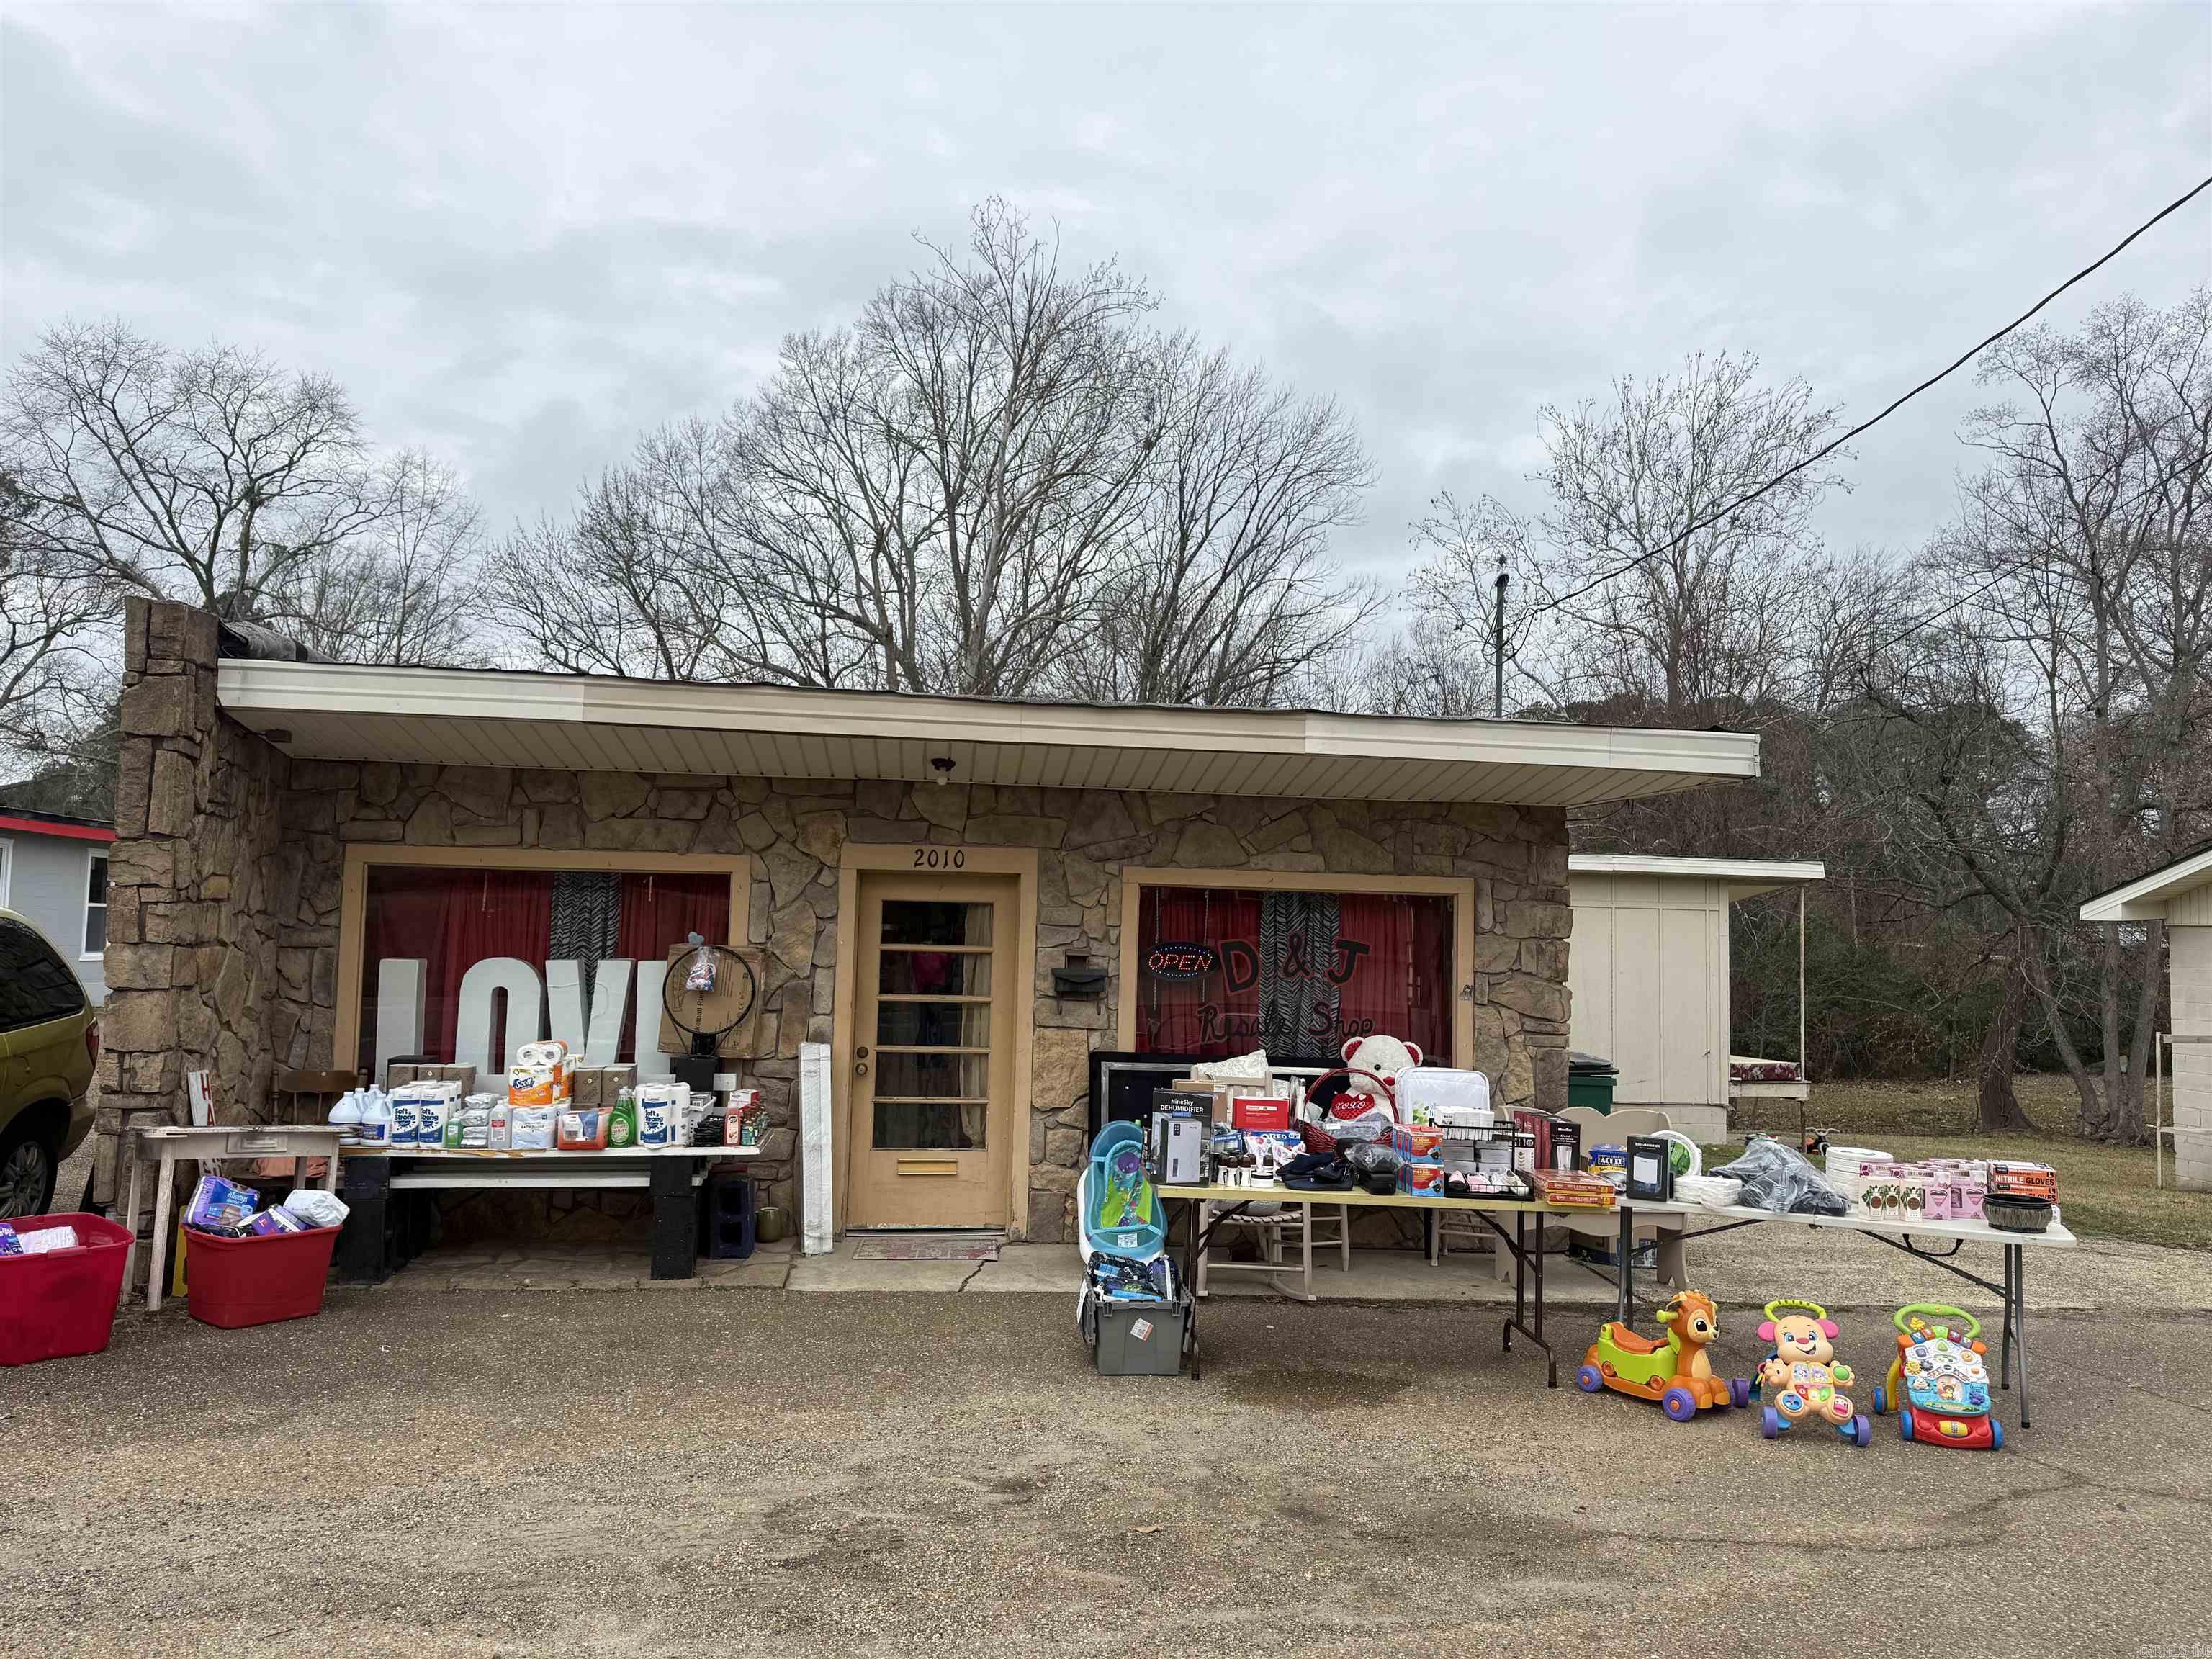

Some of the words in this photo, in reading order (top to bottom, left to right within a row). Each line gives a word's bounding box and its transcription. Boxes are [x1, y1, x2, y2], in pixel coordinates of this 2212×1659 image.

[914, 848, 965, 869] 2010
[1148, 953, 1213, 971] OPEN
[1220, 939, 1259, 995] D
[1282, 933, 1313, 977] &
[1326, 939, 1371, 984] J
[1160, 1105, 1205, 1113] DEHUMIDIFIER
[1995, 1175, 2024, 1184] NITRILE
[2026, 1177, 2054, 1186] GLOVES
